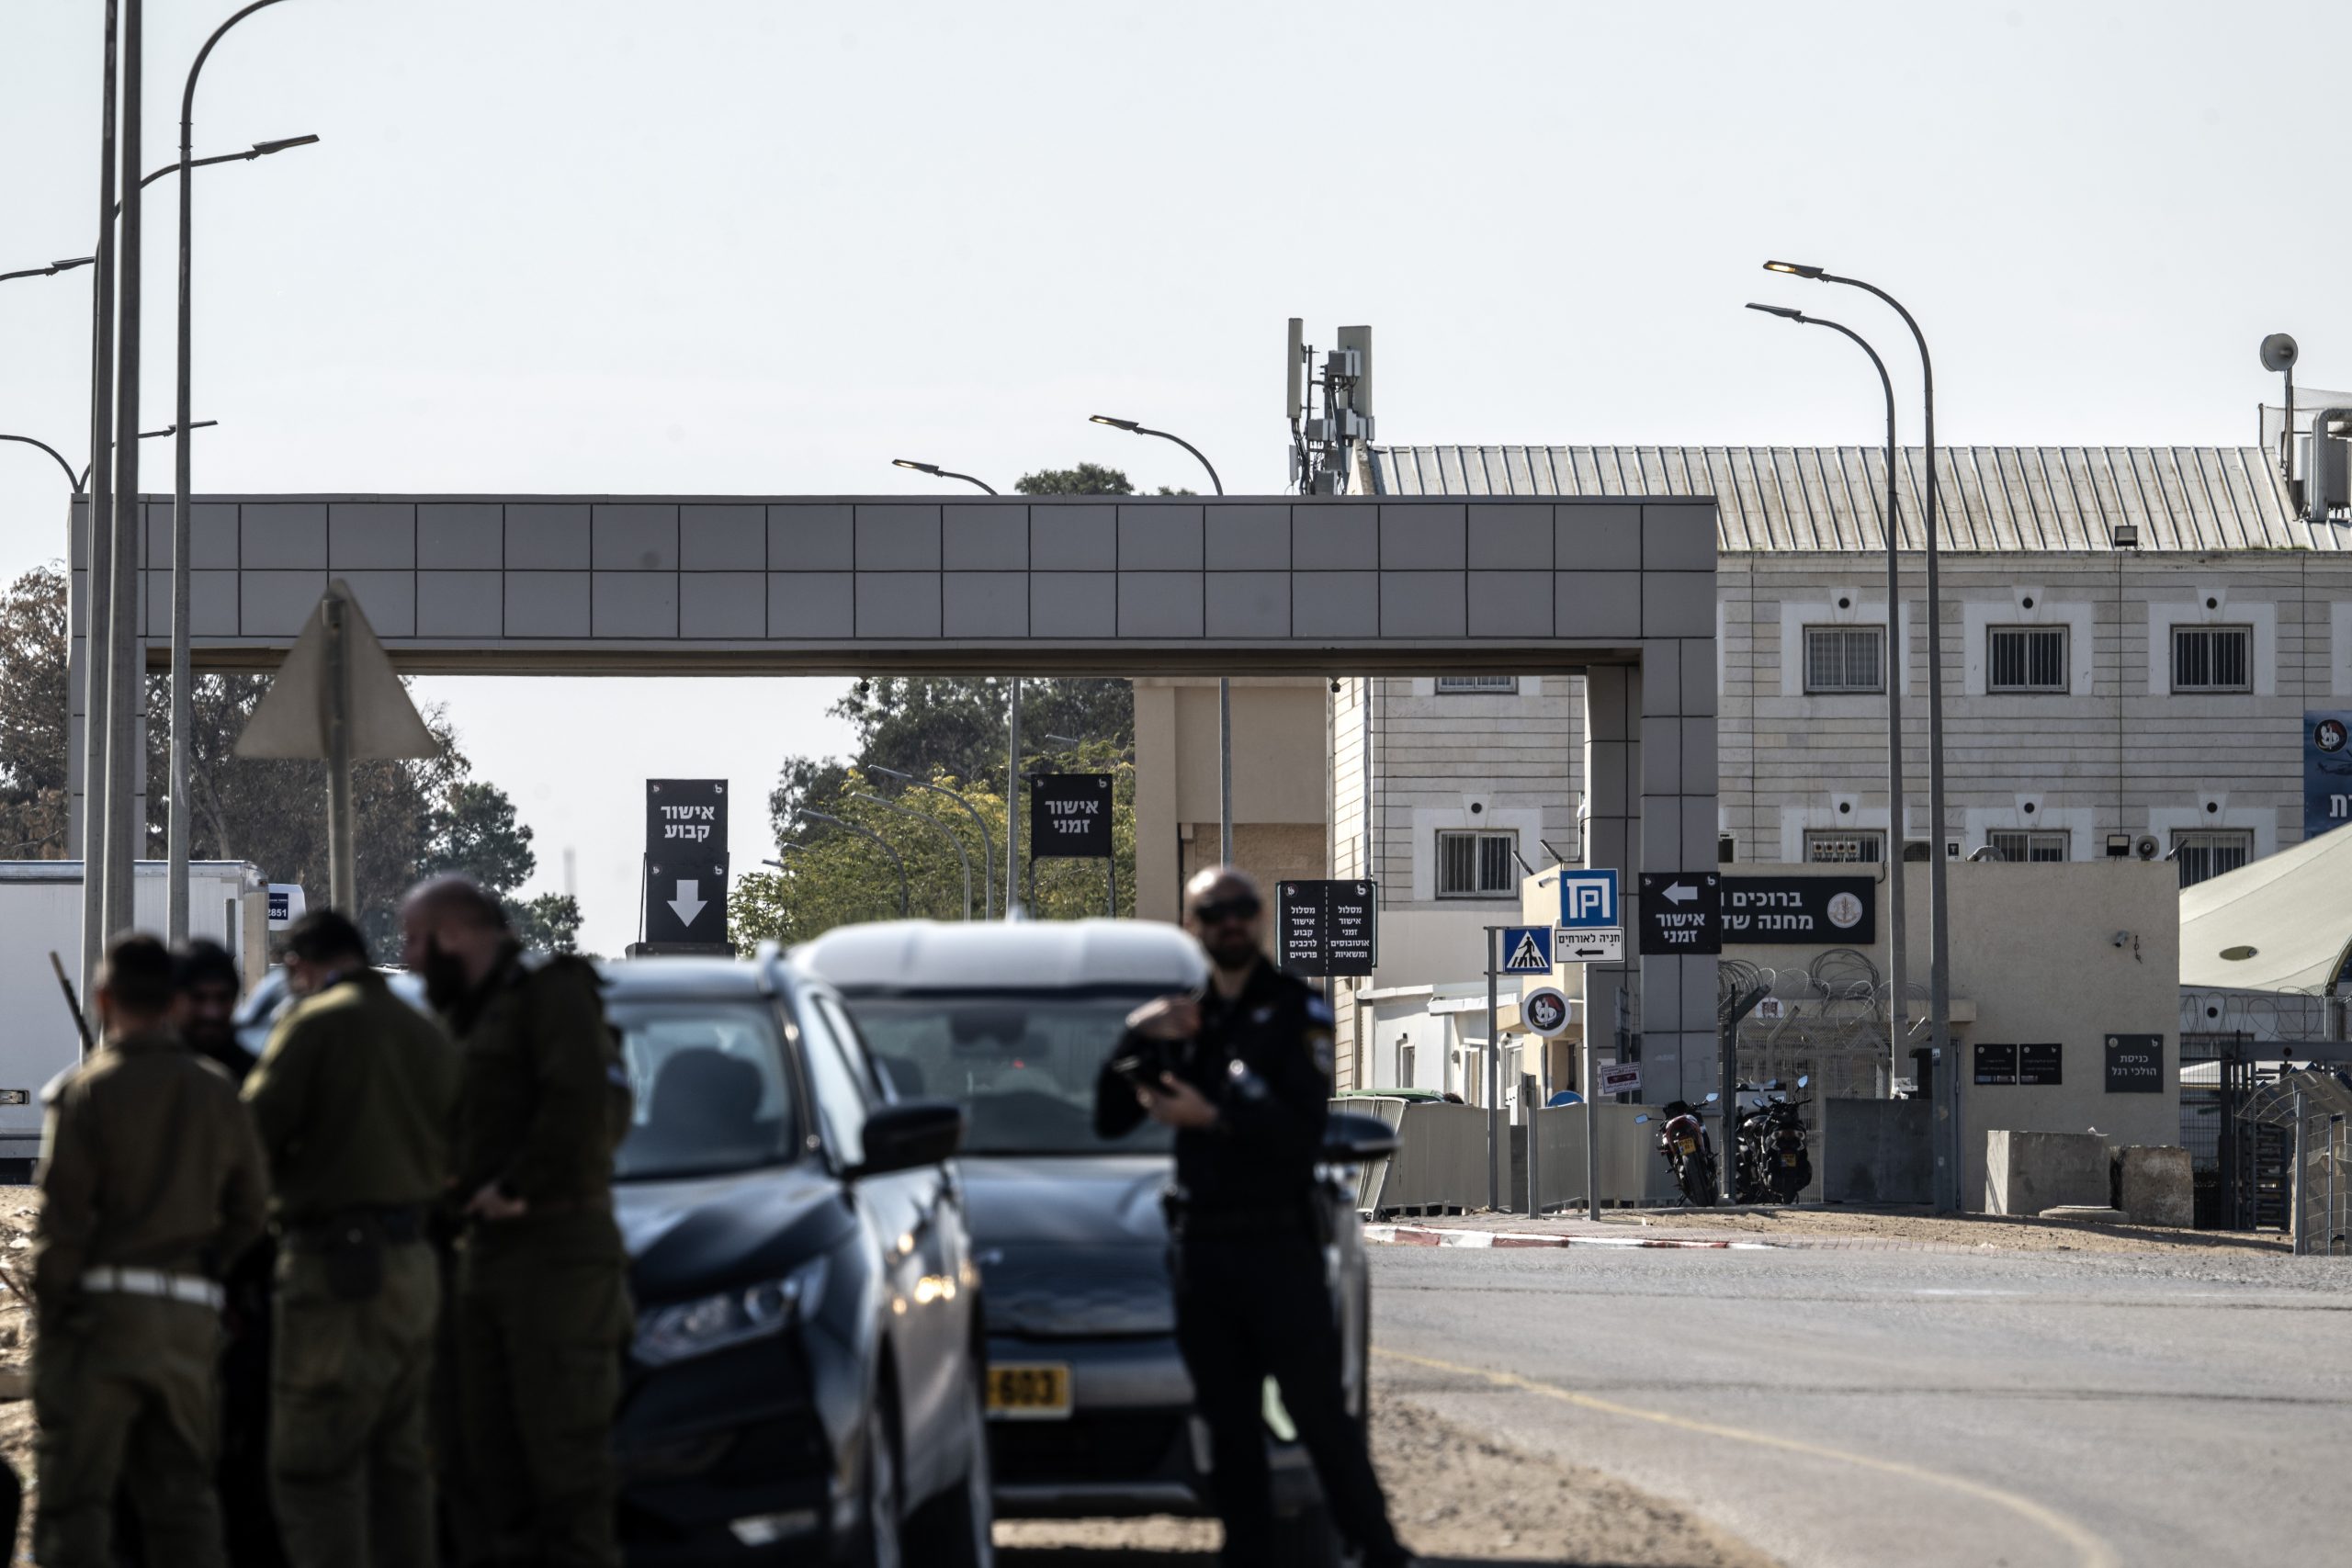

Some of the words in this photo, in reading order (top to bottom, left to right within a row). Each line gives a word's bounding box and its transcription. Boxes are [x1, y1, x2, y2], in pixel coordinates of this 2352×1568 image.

[661, 806, 715, 820] אישור
[1045, 801, 1099, 815] אישור
[1053, 819, 1091, 834] זמני
[664, 825, 710, 842] קבוע
[1733, 892, 1803, 908] ברוכים
[1291, 906, 1316, 914] מסלול
[1338, 906, 1363, 914] מסלול
[1656, 914, 1706, 928] אישור
[1758, 915, 1814, 931] מחנה
[1294, 930, 1314, 938] קבוע
[1558, 934, 1596, 944] לאורחים
[1600, 934, 1621, 942] חניה
[1663, 931, 1698, 943] זמני
[1289, 939, 1317, 948] לרכבים
[2111, 1066, 2128, 1076] רגל
[2132, 1066, 2157, 1076] הולכי
